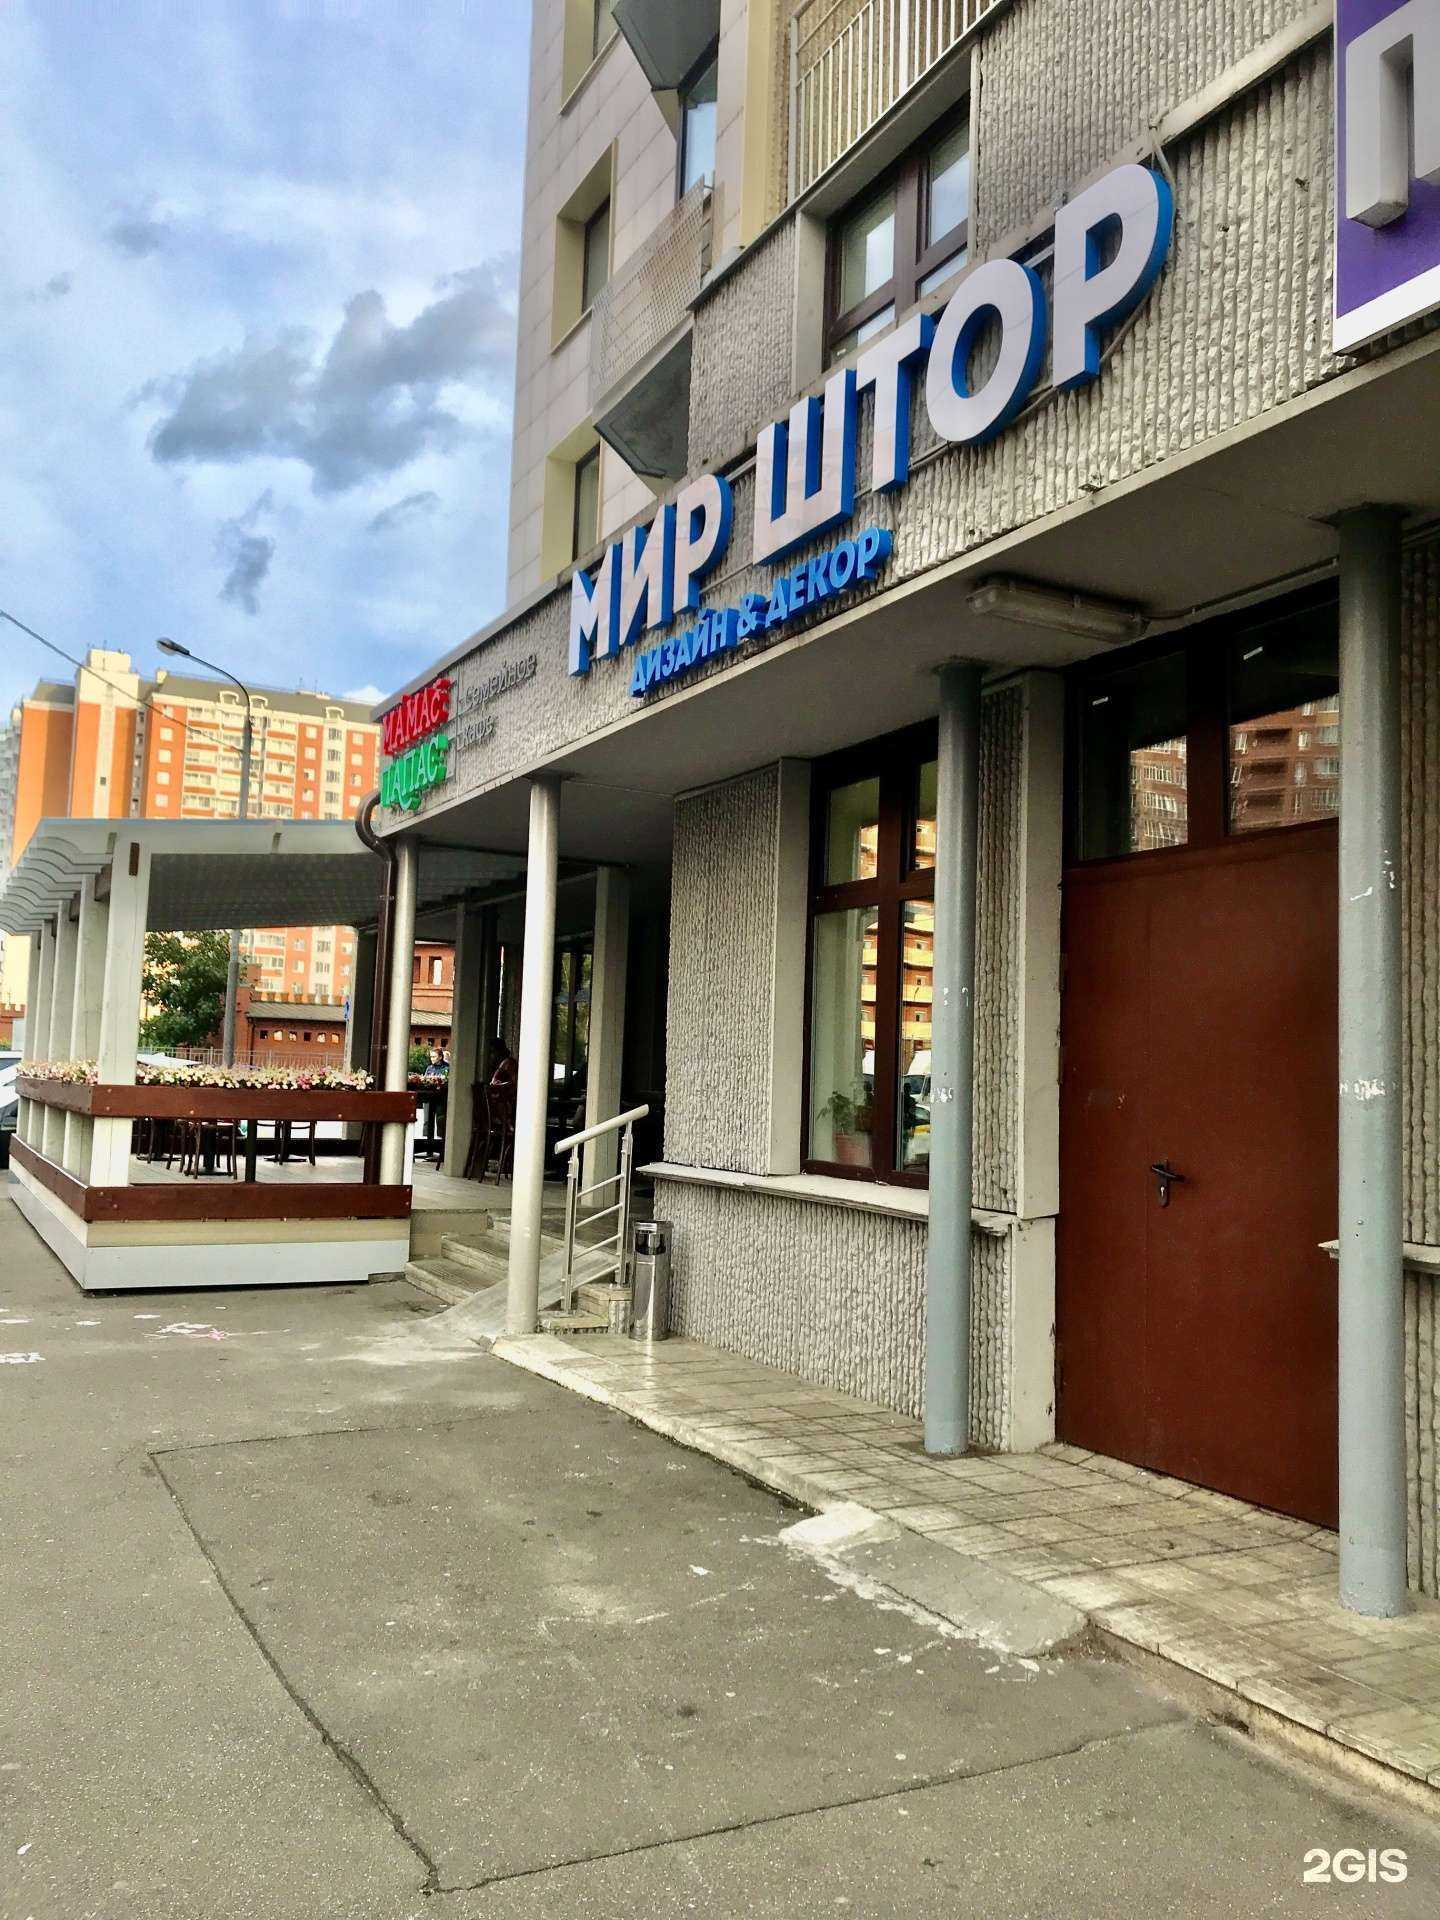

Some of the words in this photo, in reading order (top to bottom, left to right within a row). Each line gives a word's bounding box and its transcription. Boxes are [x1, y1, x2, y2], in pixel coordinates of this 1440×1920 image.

[568, 474, 733, 676] МИР
[753, 163, 1175, 567] ШТОР
[629, 607, 739, 698] ДИЗАЙН
[736, 593, 769, 640] &
[764, 527, 893, 631] ДЕКОР
